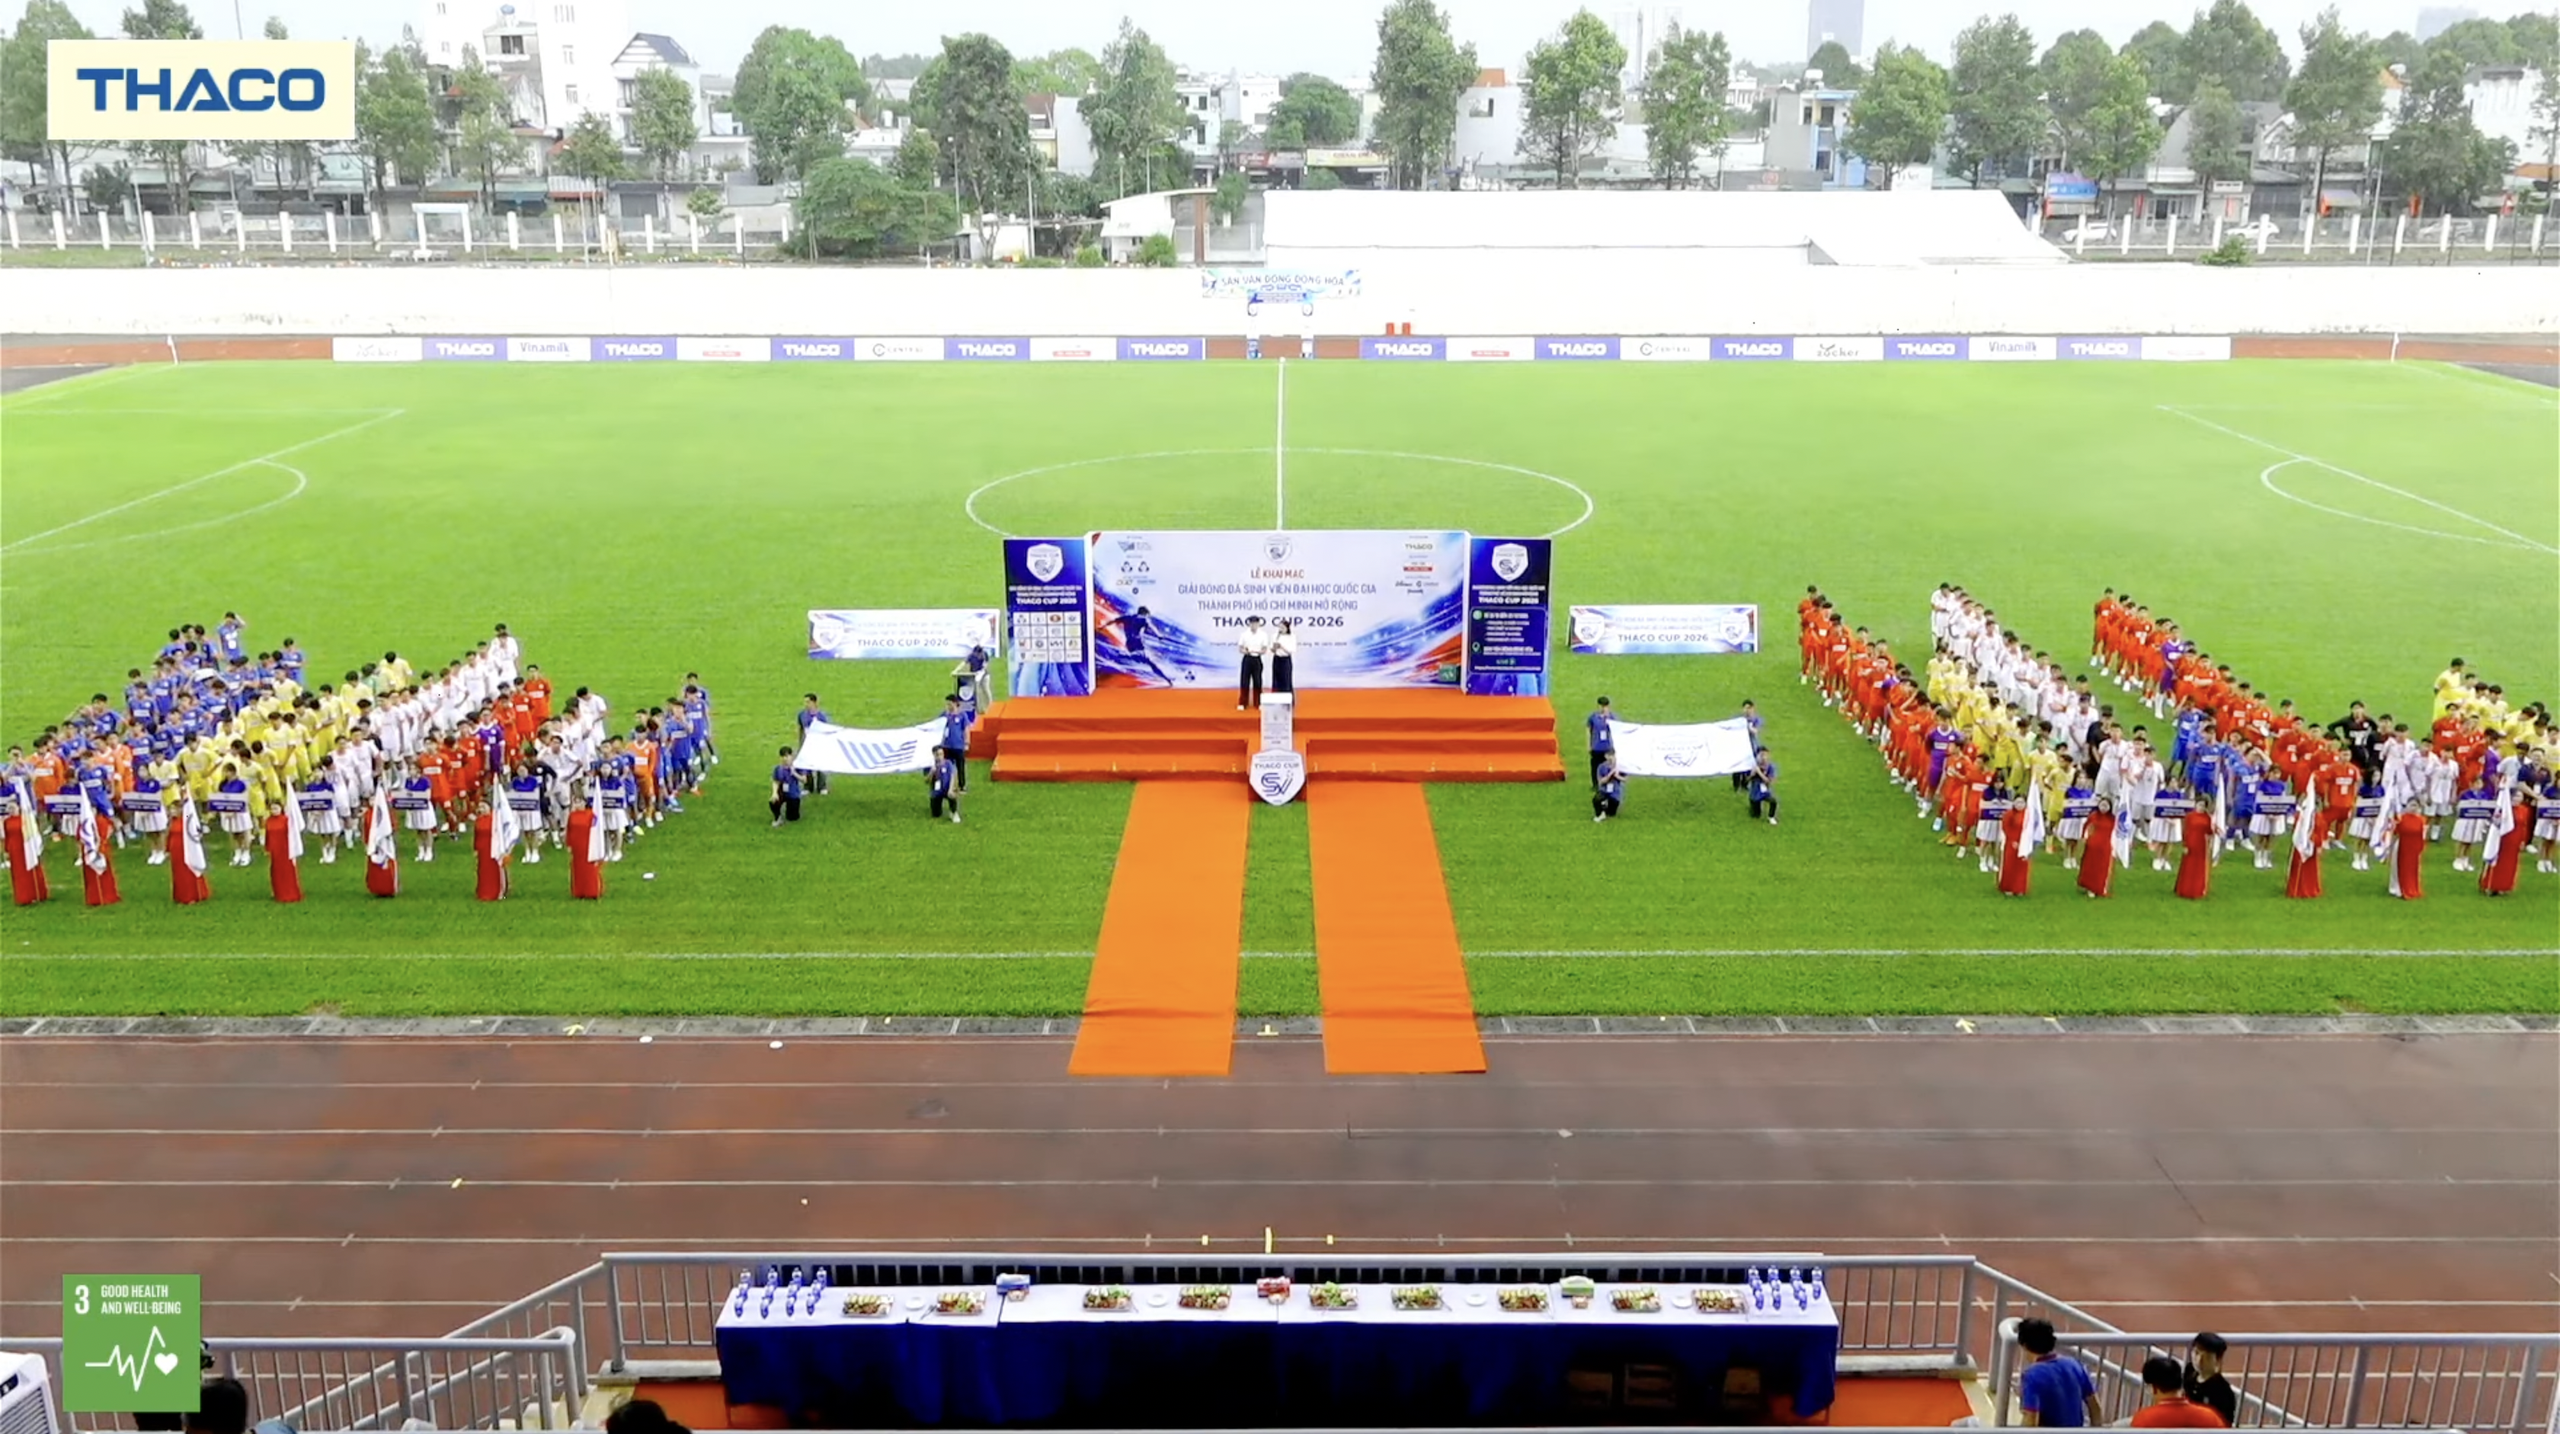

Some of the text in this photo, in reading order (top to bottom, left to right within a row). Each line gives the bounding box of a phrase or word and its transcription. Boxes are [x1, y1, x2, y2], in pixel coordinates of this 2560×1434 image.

[436, 343, 495, 356] THACO
[520, 342, 569, 354] Vinamilk
[604, 343, 663, 356] THACO
[782, 343, 841, 356] THACO
[958, 343, 1016, 356] THACO
[1131, 343, 1189, 356] THACO
[1374, 343, 1432, 356] THACO
[1548, 343, 1606, 356] THACO
[1724, 343, 1783, 356] THACO
[1898, 343, 1955, 355] THACO
[1989, 341, 2037, 354] Vinamilk
[2071, 343, 2128, 355] THACO
[1308, 616, 1344, 627] 2026
[857, 638, 949, 647] THACO CUP 2026
[1617, 634, 1709, 642] THACO CUP 2026
